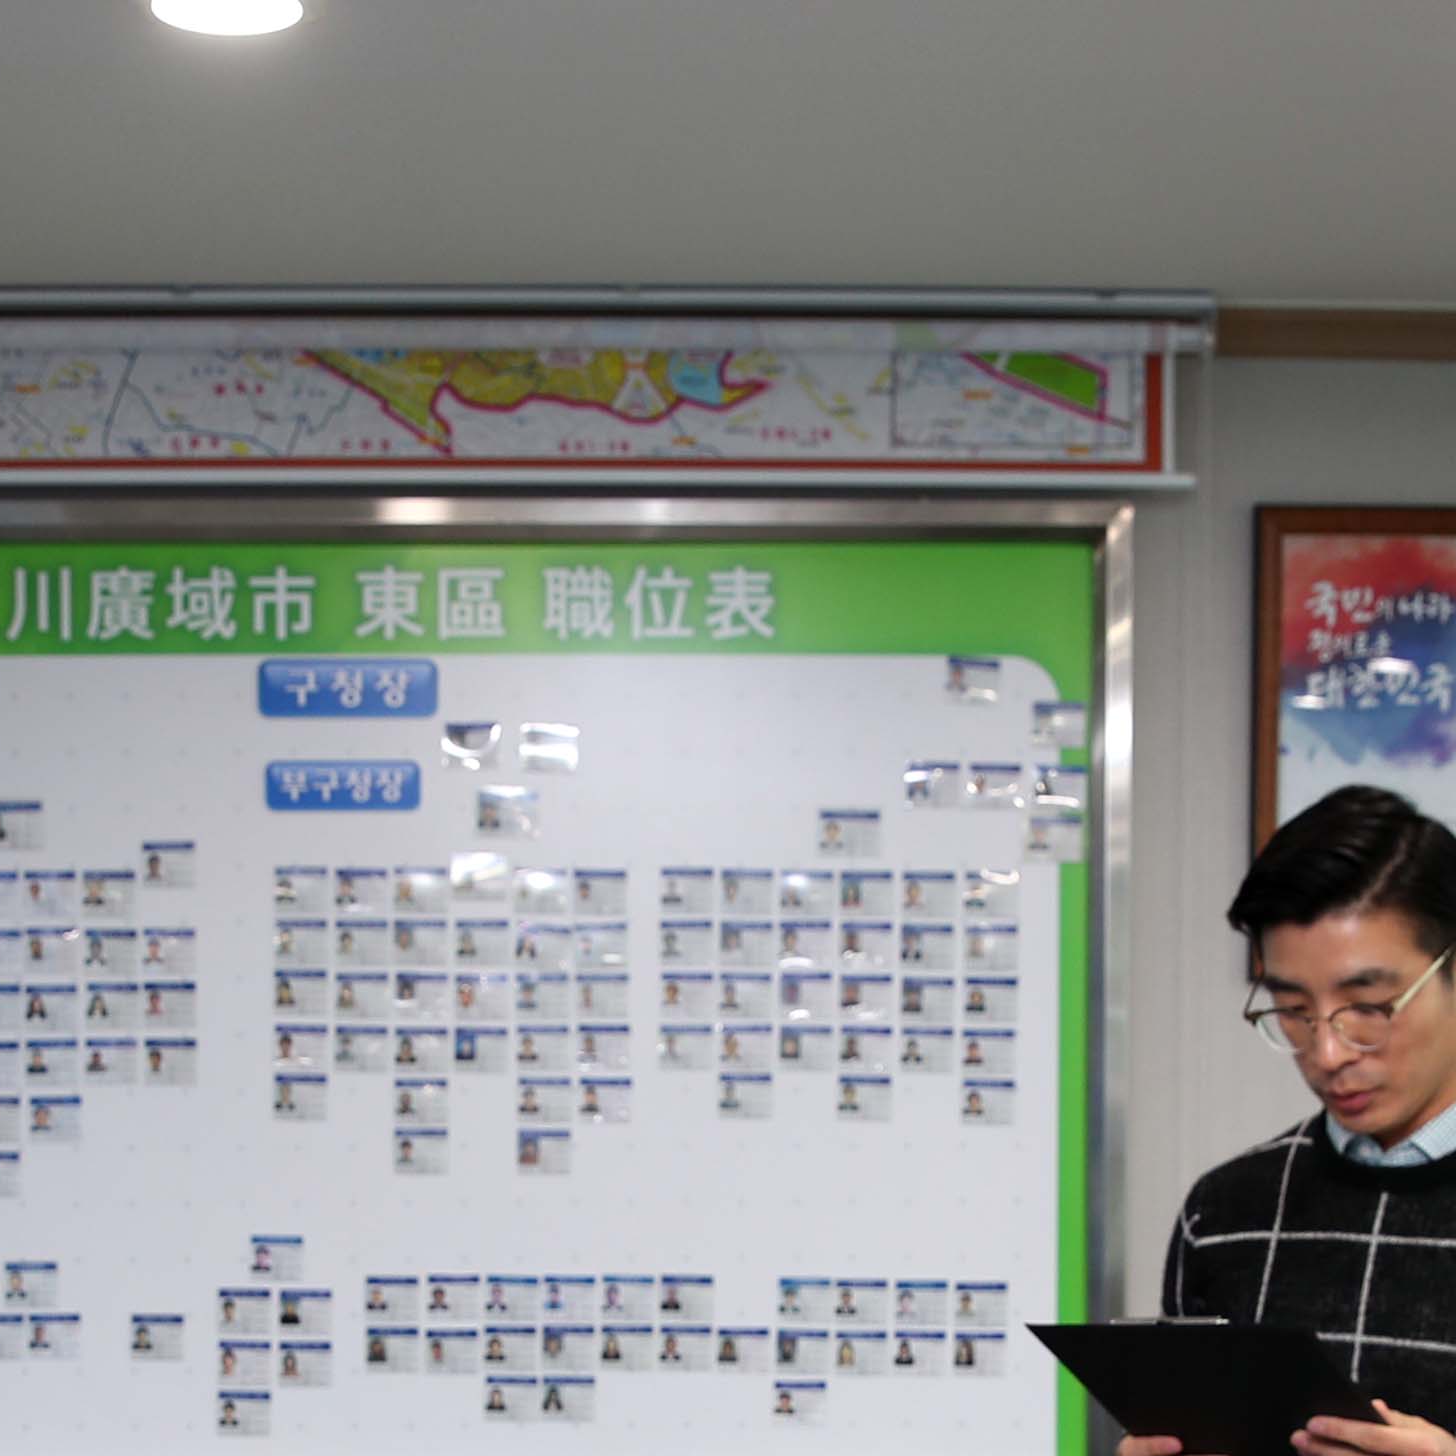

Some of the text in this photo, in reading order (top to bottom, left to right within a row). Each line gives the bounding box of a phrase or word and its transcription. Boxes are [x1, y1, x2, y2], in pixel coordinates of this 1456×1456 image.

[354, 564, 509, 644] 東區
[542, 564, 778, 643] 職位表
[285, 668, 411, 709] 구청장
[281, 769, 405, 803] 부구청장
